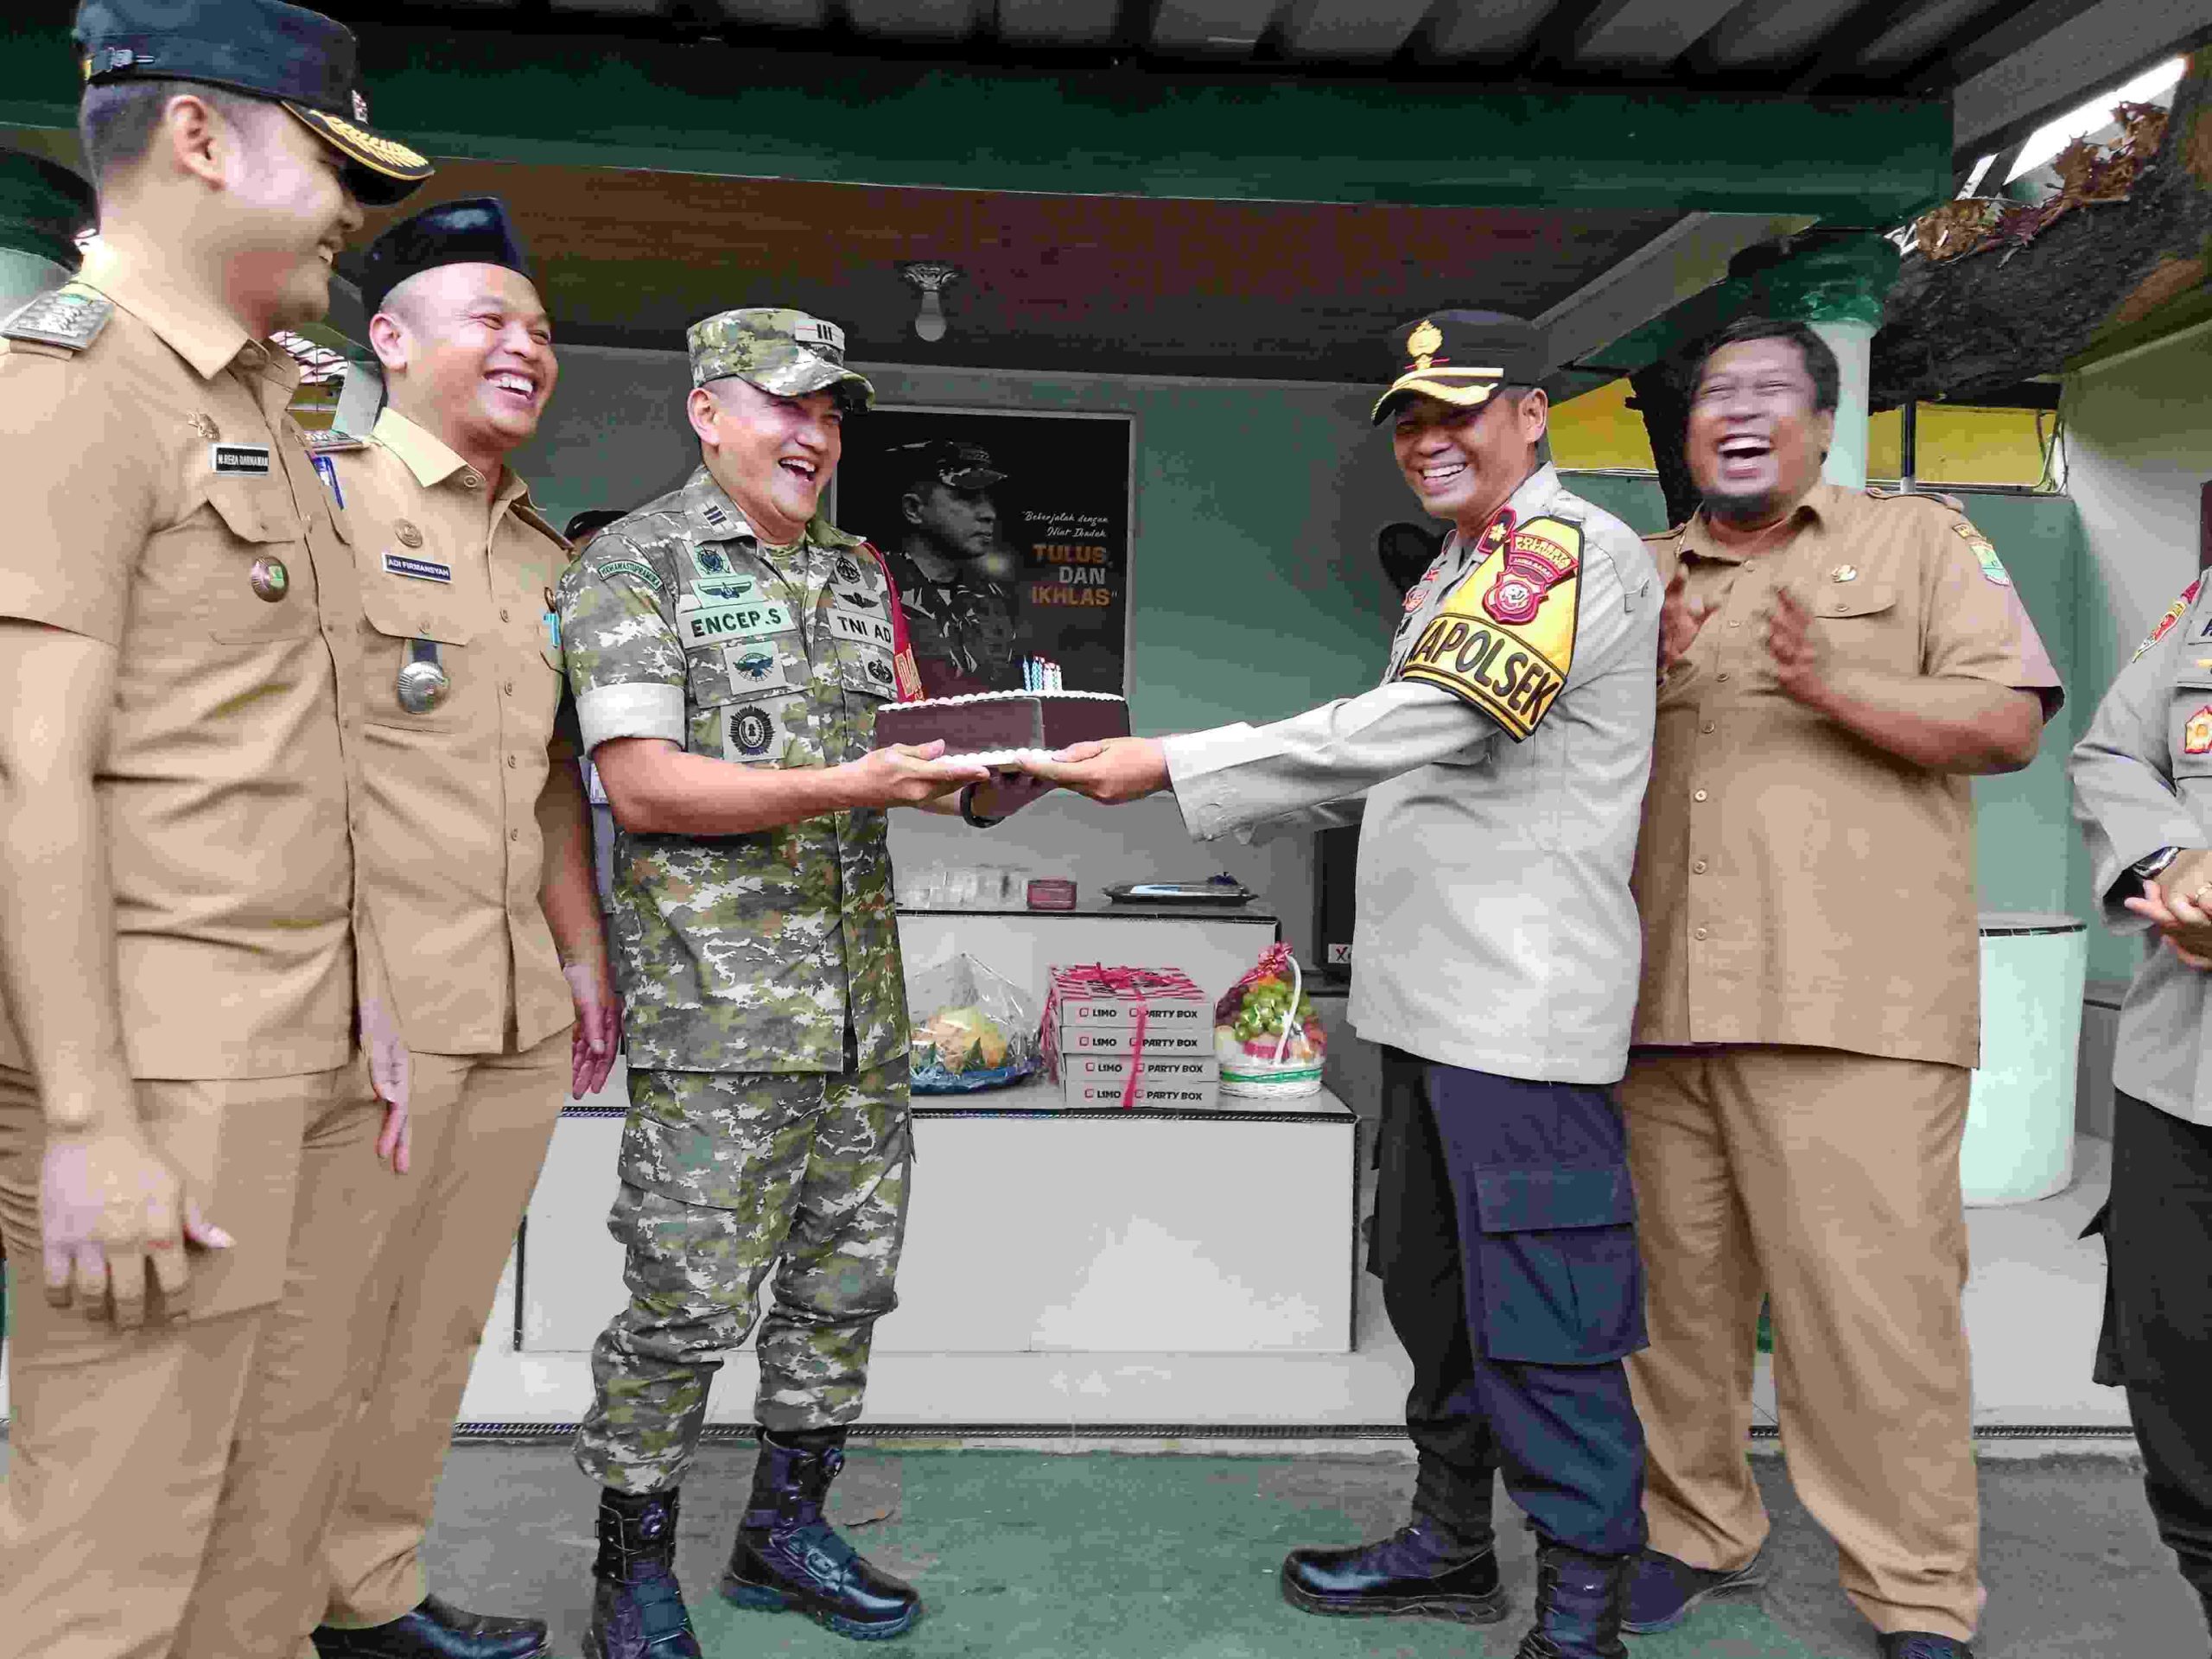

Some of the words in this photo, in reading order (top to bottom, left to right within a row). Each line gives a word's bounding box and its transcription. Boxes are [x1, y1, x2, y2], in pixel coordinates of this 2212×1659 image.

[1058, 566, 1105, 585] DAN
[836, 615, 868, 637] TNI
[874, 623, 893, 644] AD
[1407, 619, 1560, 726] APOLSEK
[1092, 1008, 1117, 1018] LIMO
[1176, 1009, 1198, 1019] BOX
[1092, 1038, 1117, 1047] LIMO
[1142, 1039, 1175, 1047] PARTY
[1176, 1039, 1198, 1047] BOX
[1098, 1064, 1122, 1072] LIMO
[1147, 1065, 1180, 1073] PARTY
[1182, 1065, 1203, 1073] BOX
[1096, 1090, 1122, 1099] LIMO
[1147, 1091, 1179, 1100] PARTY
[1180, 1092, 1203, 1101] BOX
